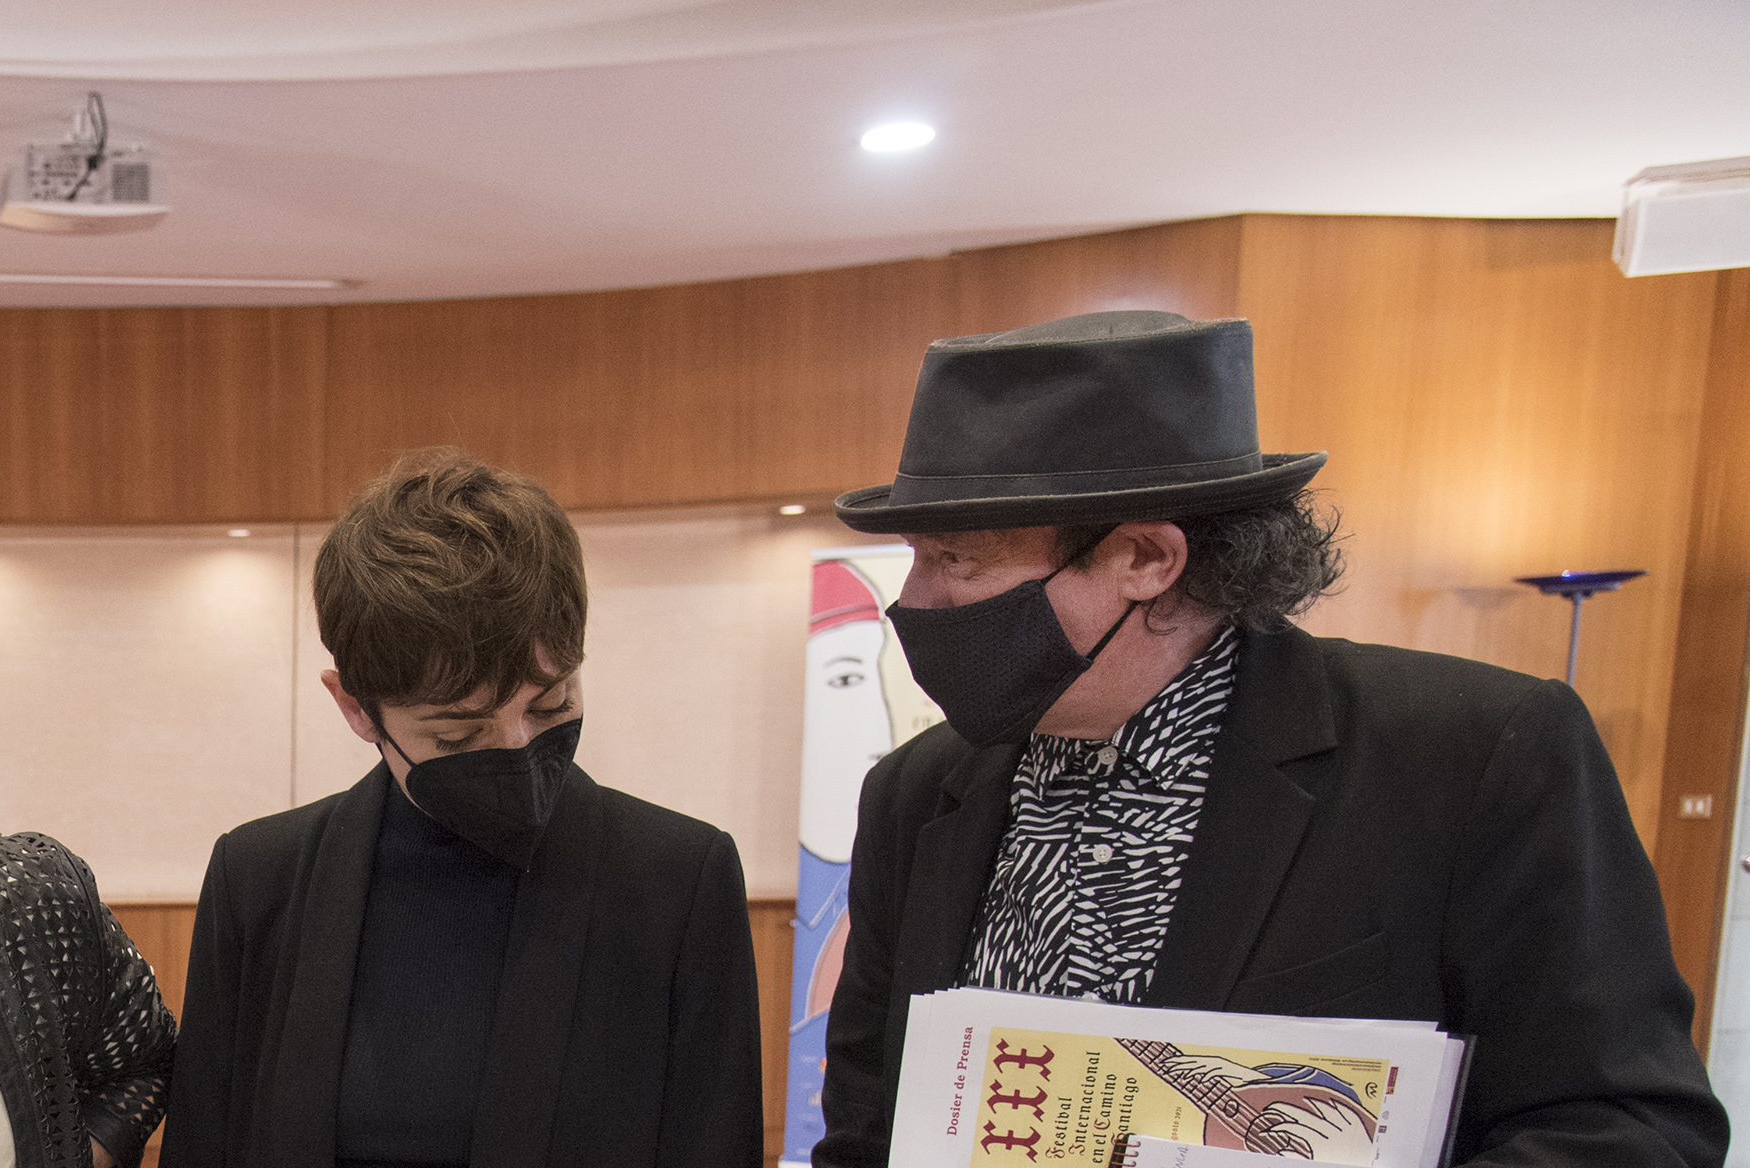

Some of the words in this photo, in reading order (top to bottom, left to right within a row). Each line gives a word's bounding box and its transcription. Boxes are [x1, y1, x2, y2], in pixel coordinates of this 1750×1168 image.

[956, 1026, 973, 1070] Prensa
[954, 1075, 965, 1090] de
[980, 1038, 1055, 1163] XXX
[1068, 1051, 1100, 1155] Internacional
[1094, 1074, 1117, 1130] Camino
[946, 1094, 963, 1136] Dosier
[1045, 1096, 1072, 1158] Festival
[1092, 1133, 1106, 1148] el
[1092, 1151, 1104, 1164] en
